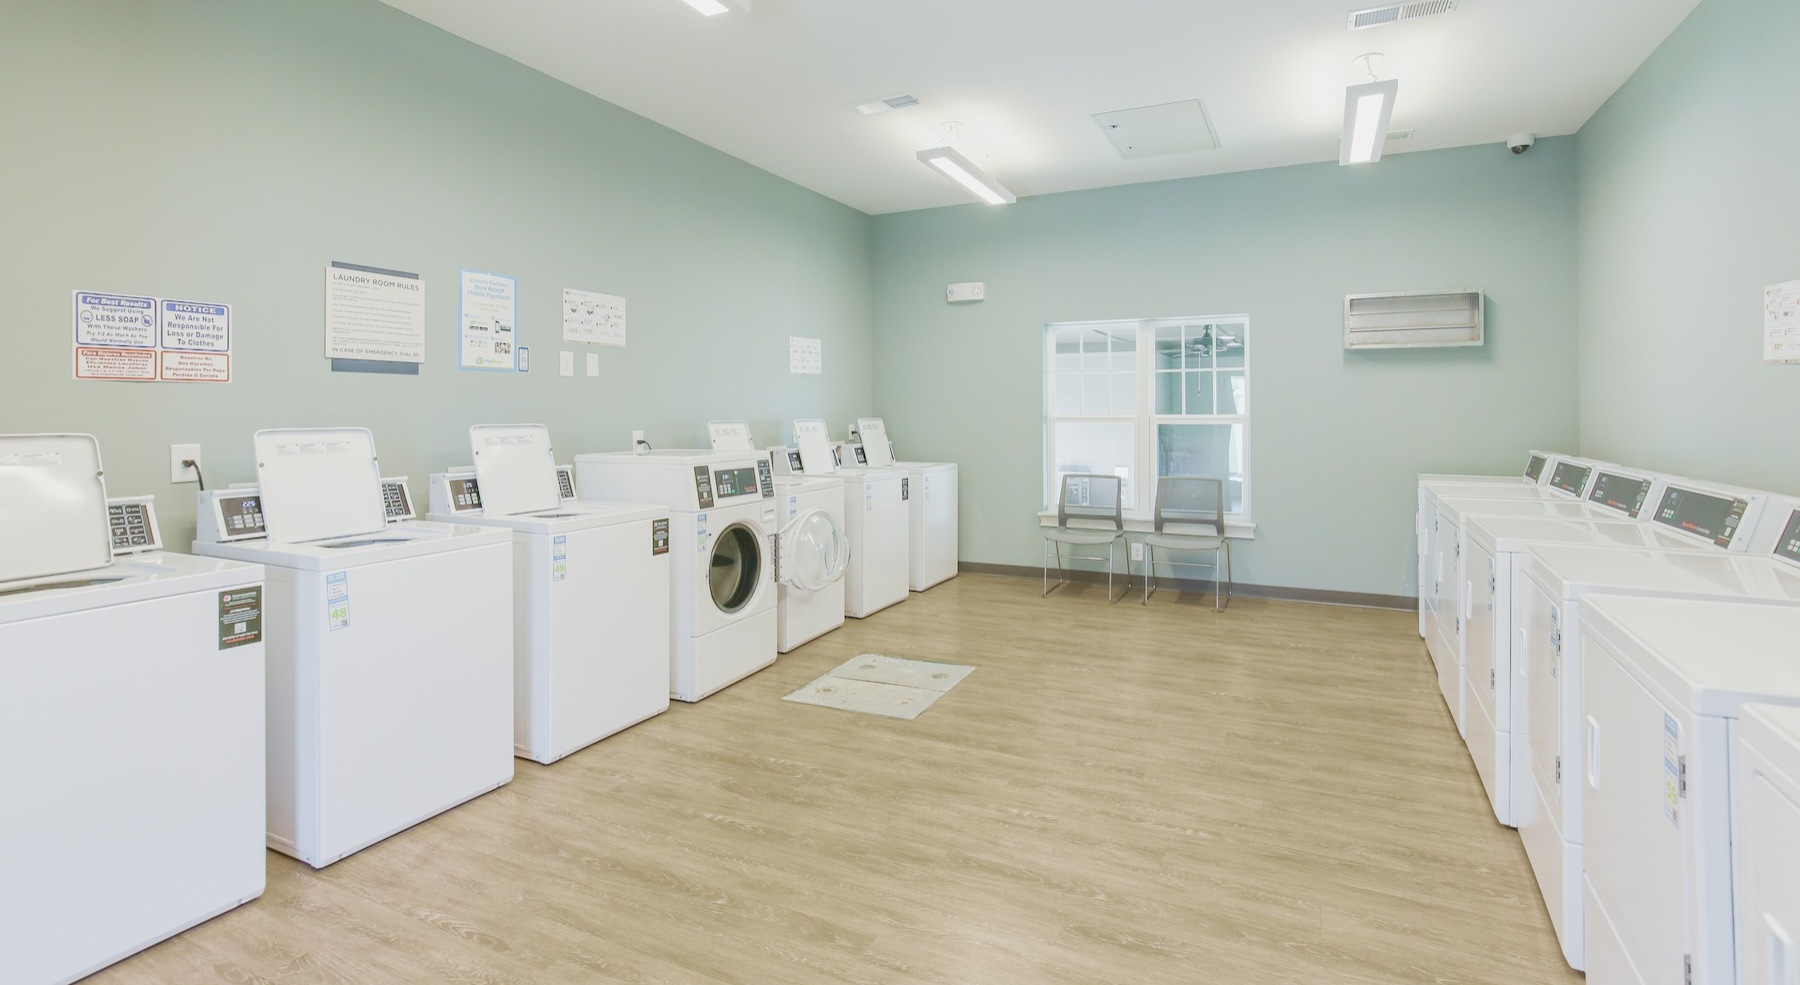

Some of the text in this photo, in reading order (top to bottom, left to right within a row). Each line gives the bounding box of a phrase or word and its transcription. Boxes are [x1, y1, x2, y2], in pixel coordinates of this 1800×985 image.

[333, 273, 371, 284] LAUNDRY
[372, 278, 395, 288] ROOM
[396, 282, 420, 291] RULES
[467, 290, 486, 298] Mobile
[175, 305, 217, 313] NOTICE
[95, 314, 116, 322] LESS
[174, 313, 186, 321] We
[167, 321, 211, 331] Responsible
[167, 329, 185, 337] Loss
[195, 331, 224, 340] Damage
[187, 339, 215, 347] Clothes
[331, 608, 347, 620] 48
